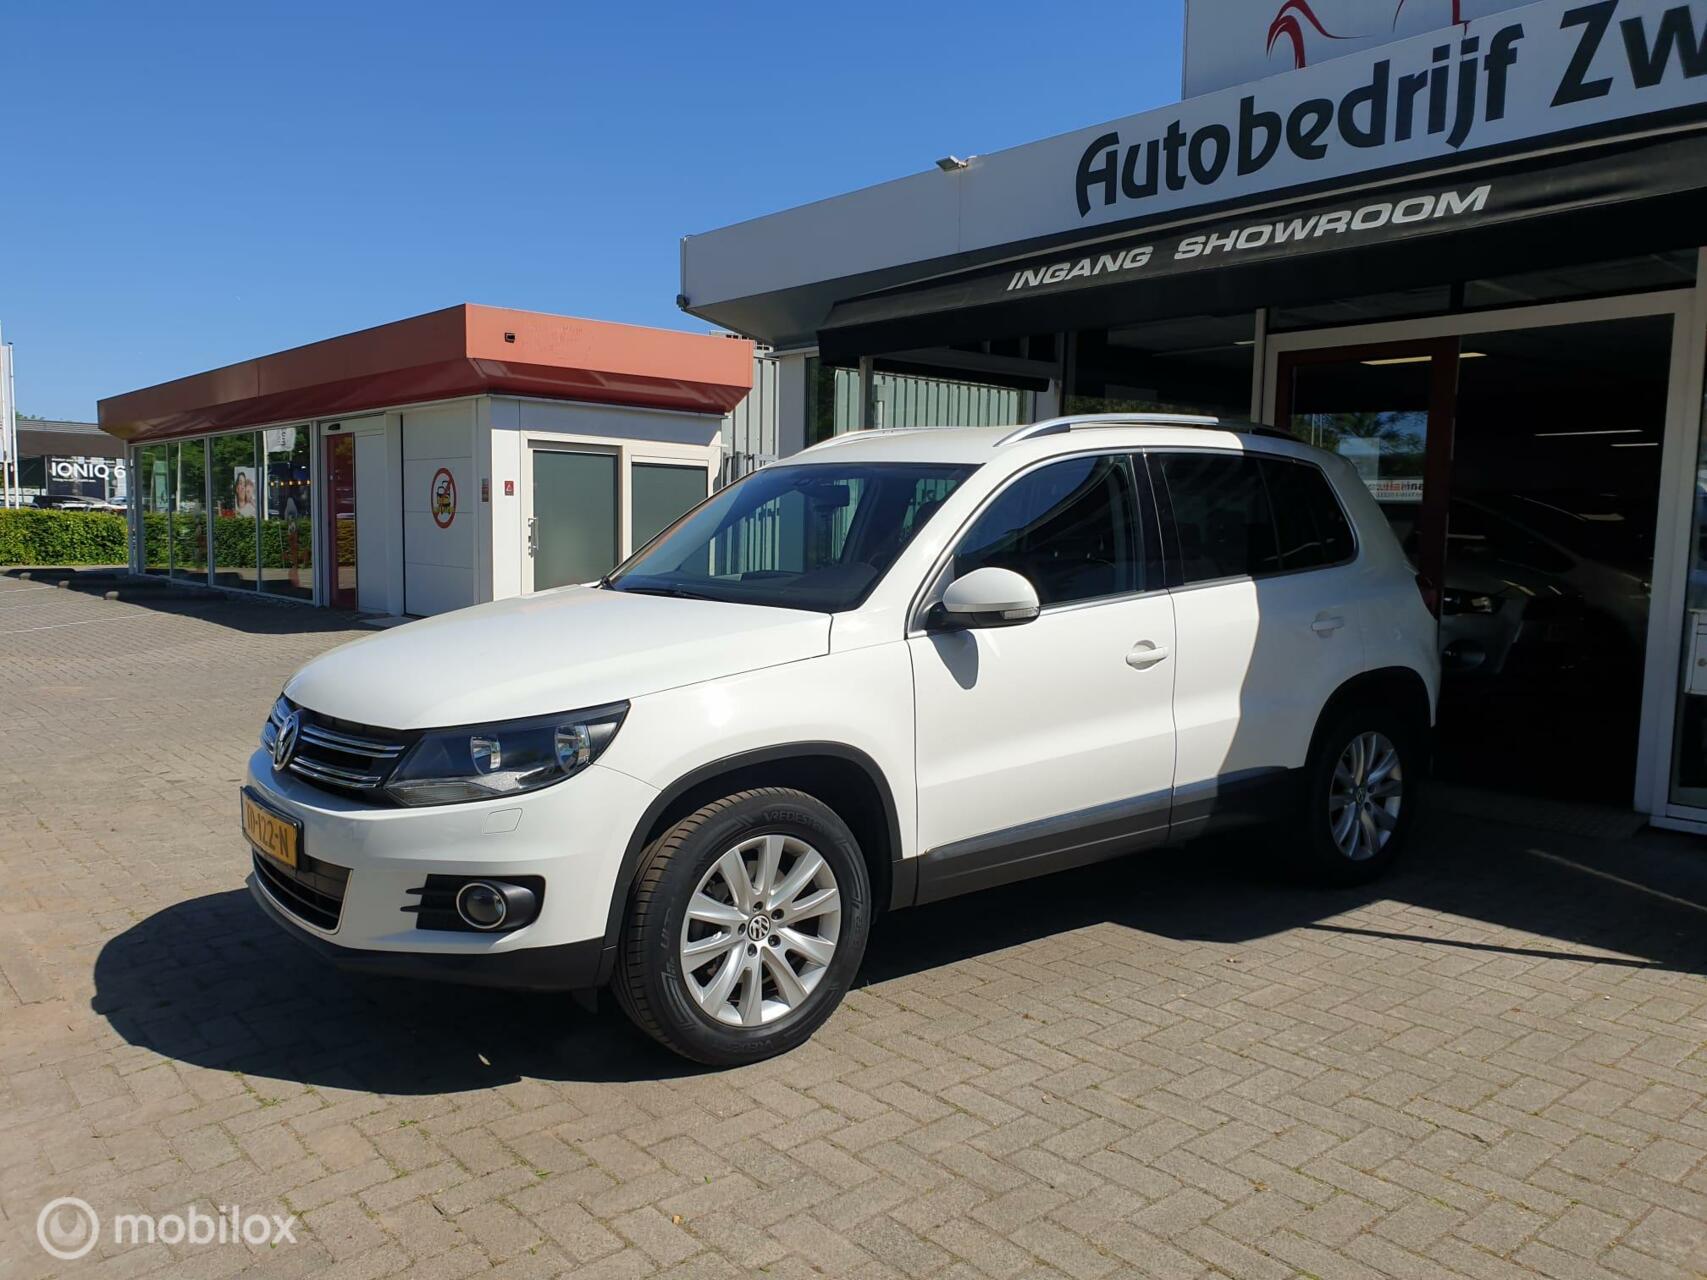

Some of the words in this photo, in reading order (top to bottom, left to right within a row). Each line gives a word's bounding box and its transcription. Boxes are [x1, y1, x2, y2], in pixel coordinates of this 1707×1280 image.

[1075, 23, 1524, 218] Autobedrijf
[1006, 246, 1154, 291] INGANG
[1173, 185, 1492, 262] SHOWROOM
[51, 461, 110, 481] IONIQ
[114, 465, 126, 479] 6
